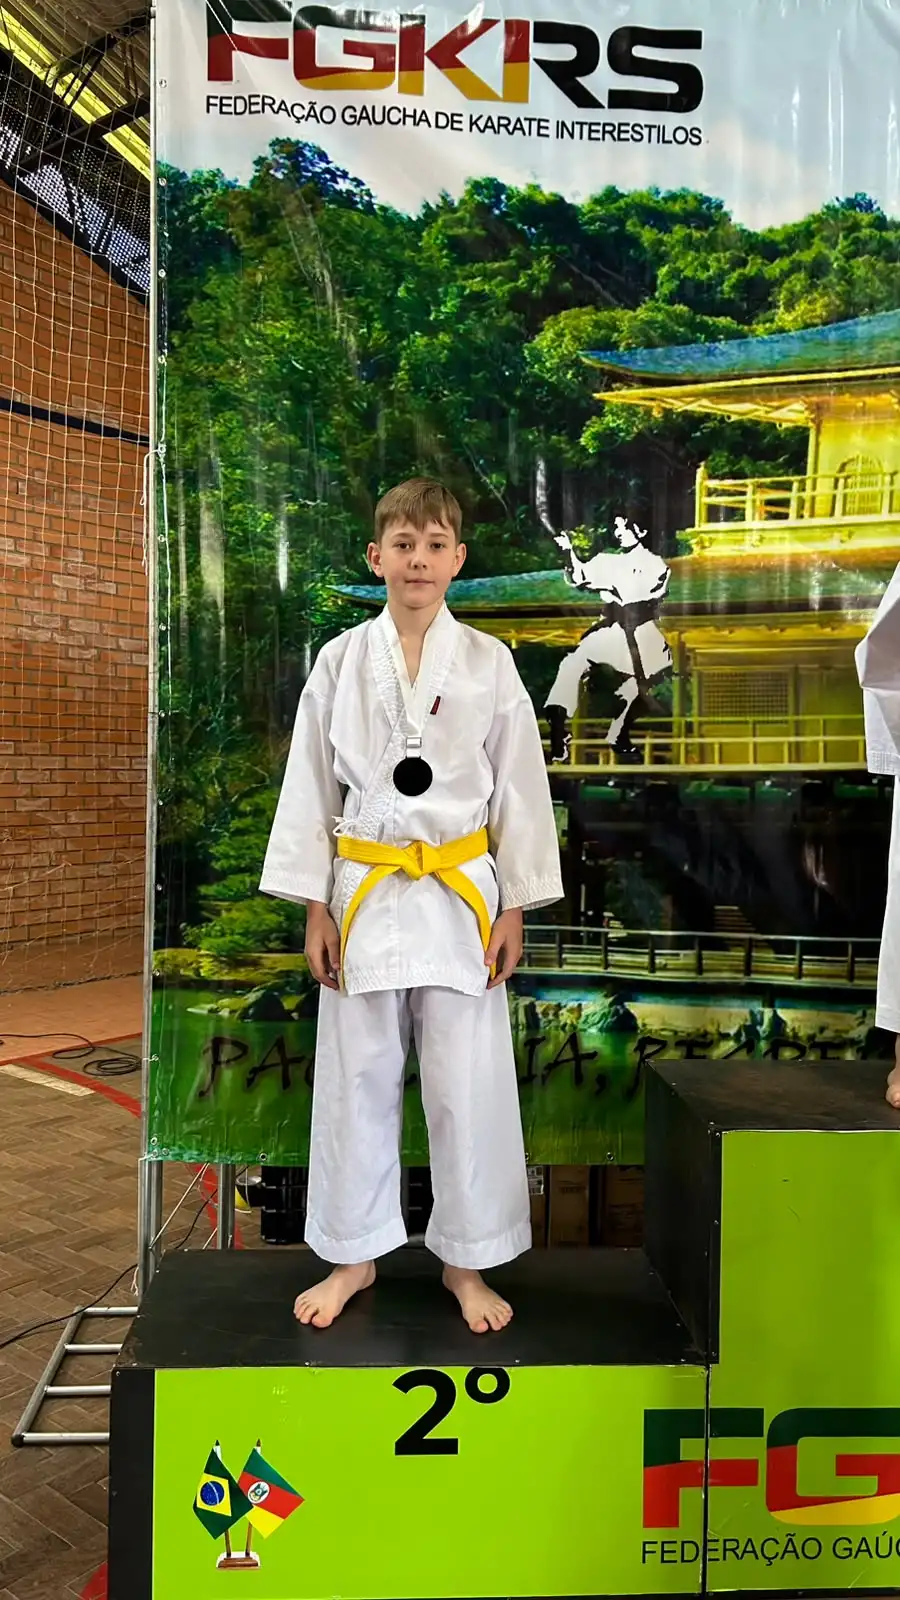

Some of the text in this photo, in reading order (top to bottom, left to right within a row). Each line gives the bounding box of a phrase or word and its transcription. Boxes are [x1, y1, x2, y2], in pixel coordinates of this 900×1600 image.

[205, 94, 702, 146] FEDERAÇÃO GAUCHA DE KARATE INTERESTILOS
[641, 1530, 900, 1566] FEDERAÇÃO GAÚ
